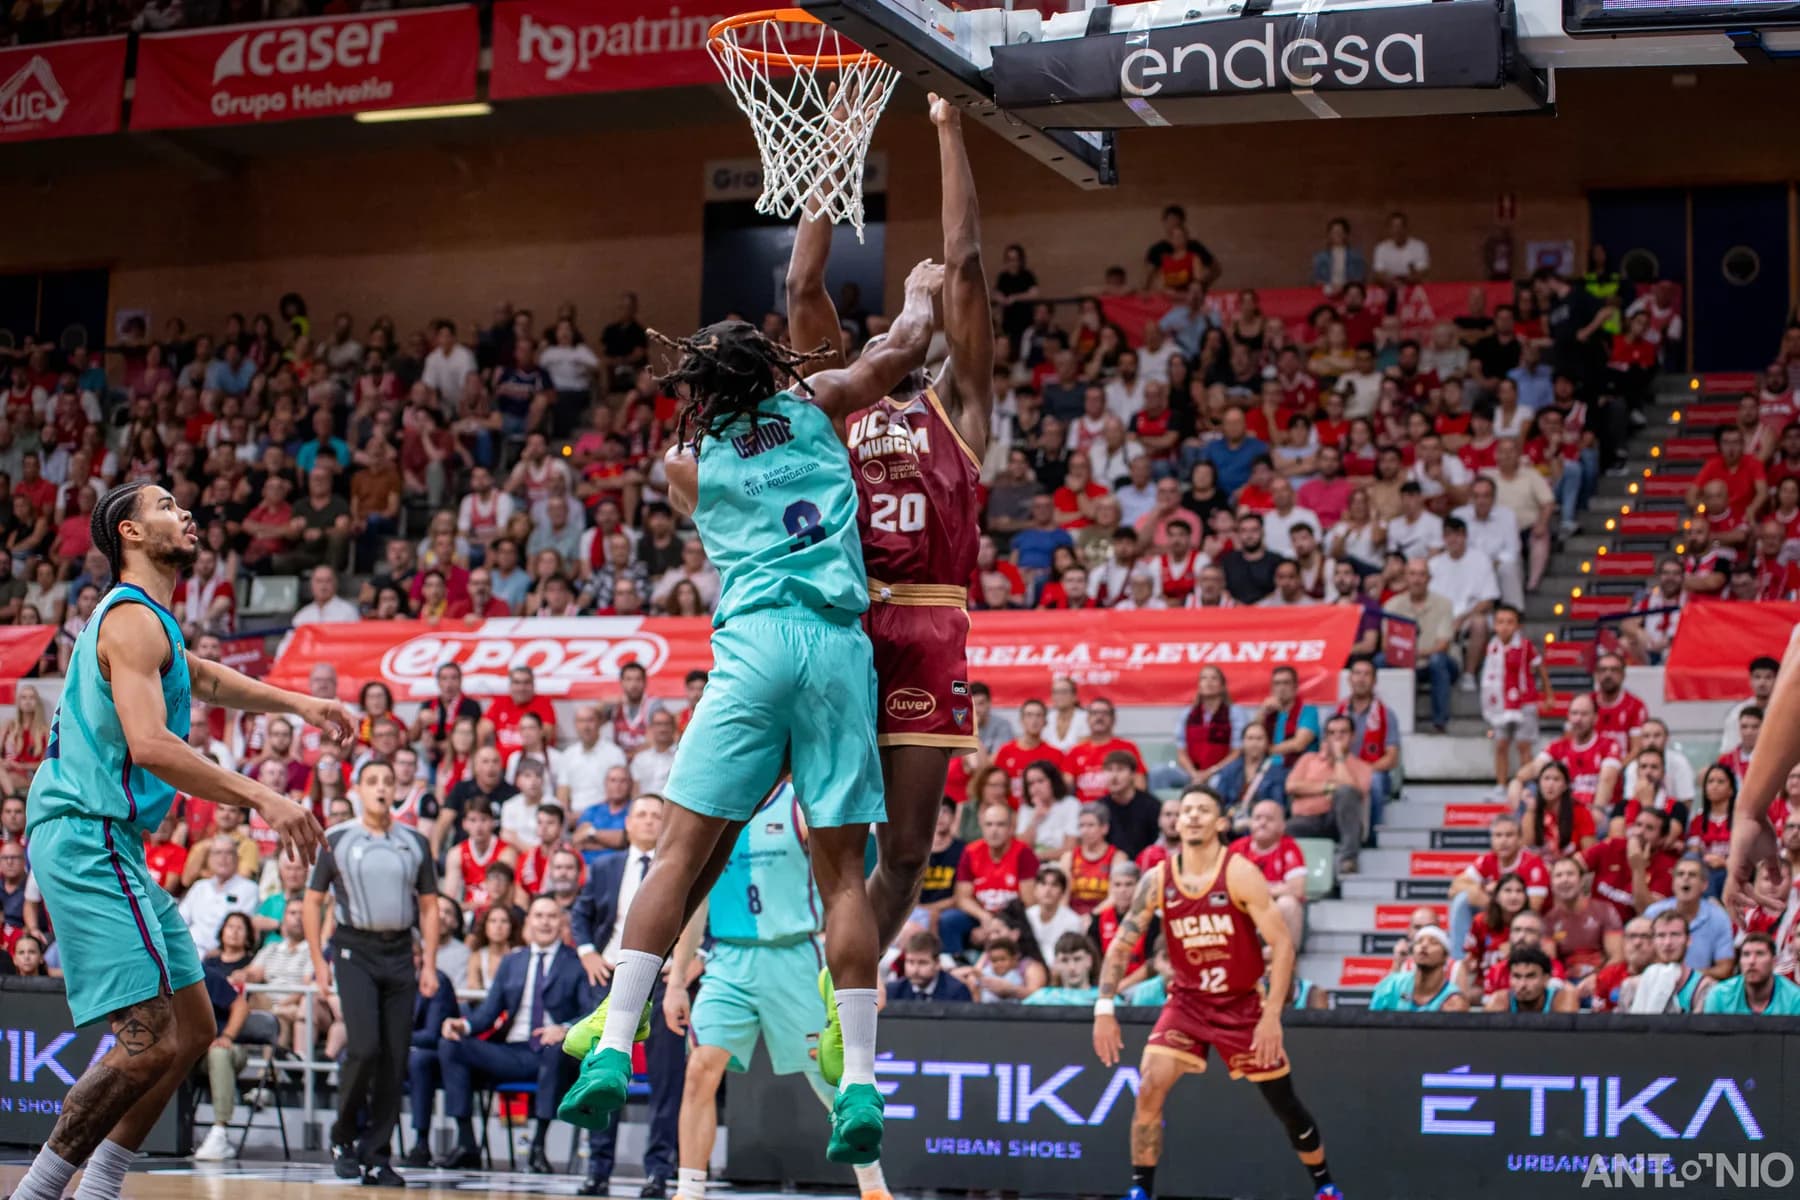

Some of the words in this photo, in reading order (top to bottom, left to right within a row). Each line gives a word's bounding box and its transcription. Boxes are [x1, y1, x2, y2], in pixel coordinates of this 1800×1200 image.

[249, 20, 398, 76] caser
[1121, 22, 1424, 97] endesa
[211, 92, 286, 120] Grupo
[292, 76, 393, 110] Helvetia
[859, 436, 919, 461] MURCI
[767, 462, 820, 489] FOUNDATION
[870, 492, 926, 532] 20
[1127, 640, 1325, 667] LEVANTE
[889, 698, 931, 711] Juver
[746, 884, 762, 915] 8
[1169, 914, 1234, 940] UCAM
[1199, 967, 1229, 994] 12
[18, 1099, 63, 1115] SHOE
[925, 1137, 1001, 1156] URBAN
[1008, 1139, 1083, 1159] SHOES
[1507, 1153, 1591, 1172] URBAN
